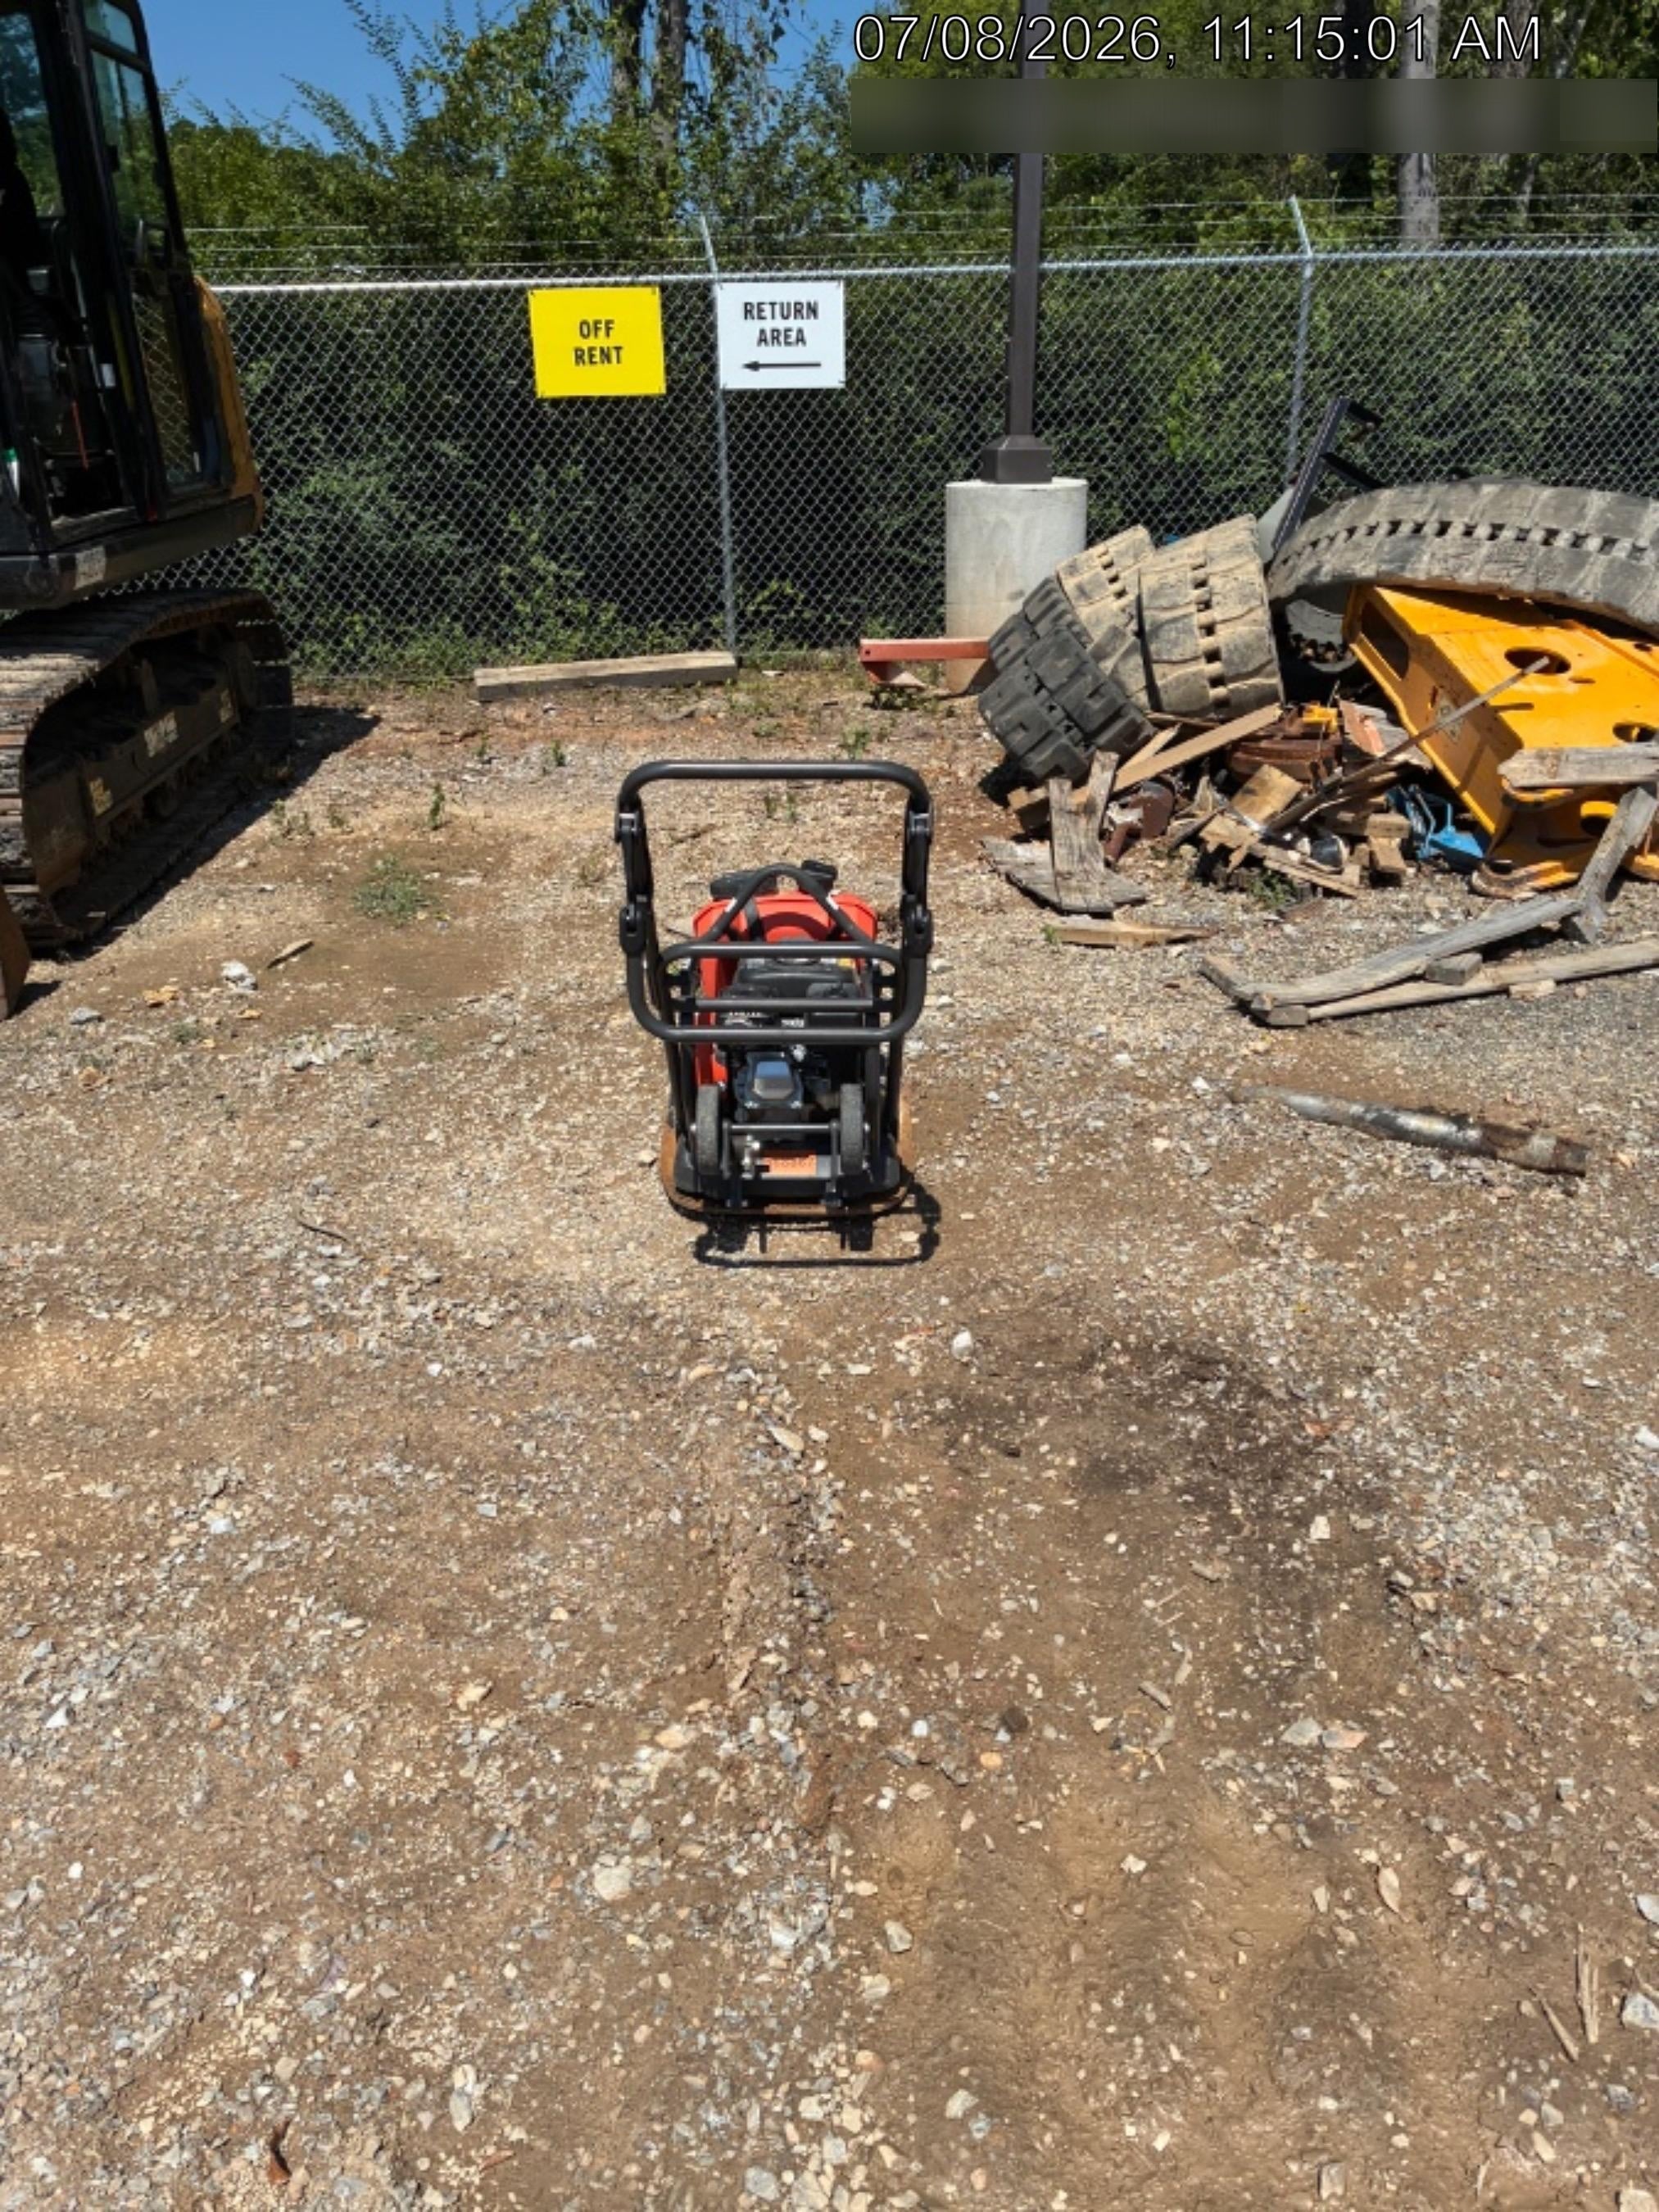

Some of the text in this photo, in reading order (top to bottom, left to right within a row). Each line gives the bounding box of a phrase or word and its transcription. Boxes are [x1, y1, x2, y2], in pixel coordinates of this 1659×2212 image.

[743, 301, 818, 321] RETURN
[578, 319, 614, 340] OFF
[756, 327, 807, 347] AREA
[573, 345, 623, 366] RENT
